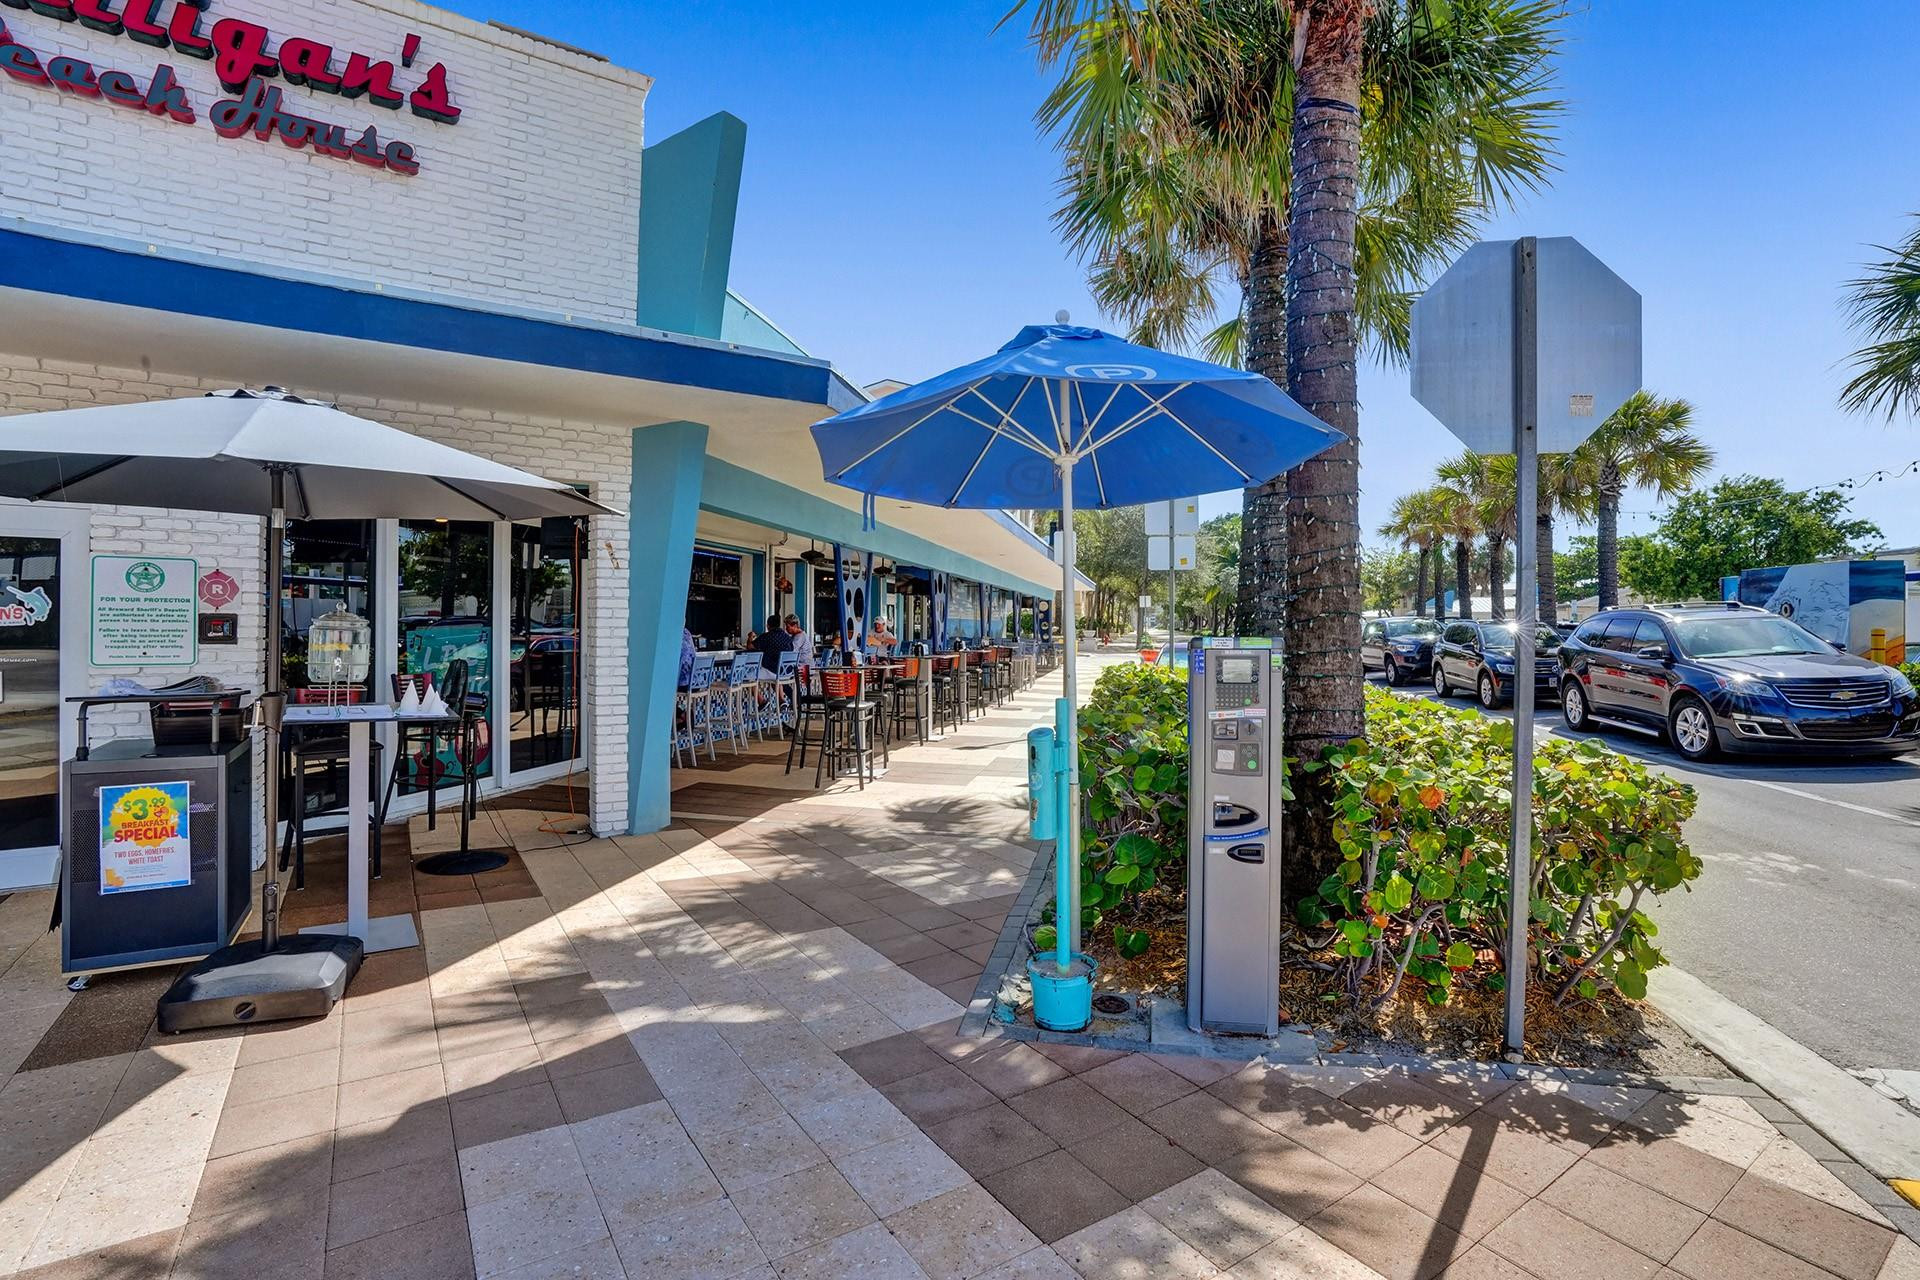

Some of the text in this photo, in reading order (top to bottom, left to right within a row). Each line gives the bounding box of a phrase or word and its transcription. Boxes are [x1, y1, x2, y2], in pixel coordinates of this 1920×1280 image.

[0, 17, 420, 176] each House
[1091, 368, 1132, 379] P
[211, 583, 224, 595] R
[123, 797, 166, 821] $3.99
[121, 818, 169, 830] BREAKFAST
[114, 825, 179, 843] SPECIAL
[114, 851, 127, 859] TWO
[128, 855, 164, 865] WHITE TOAST
